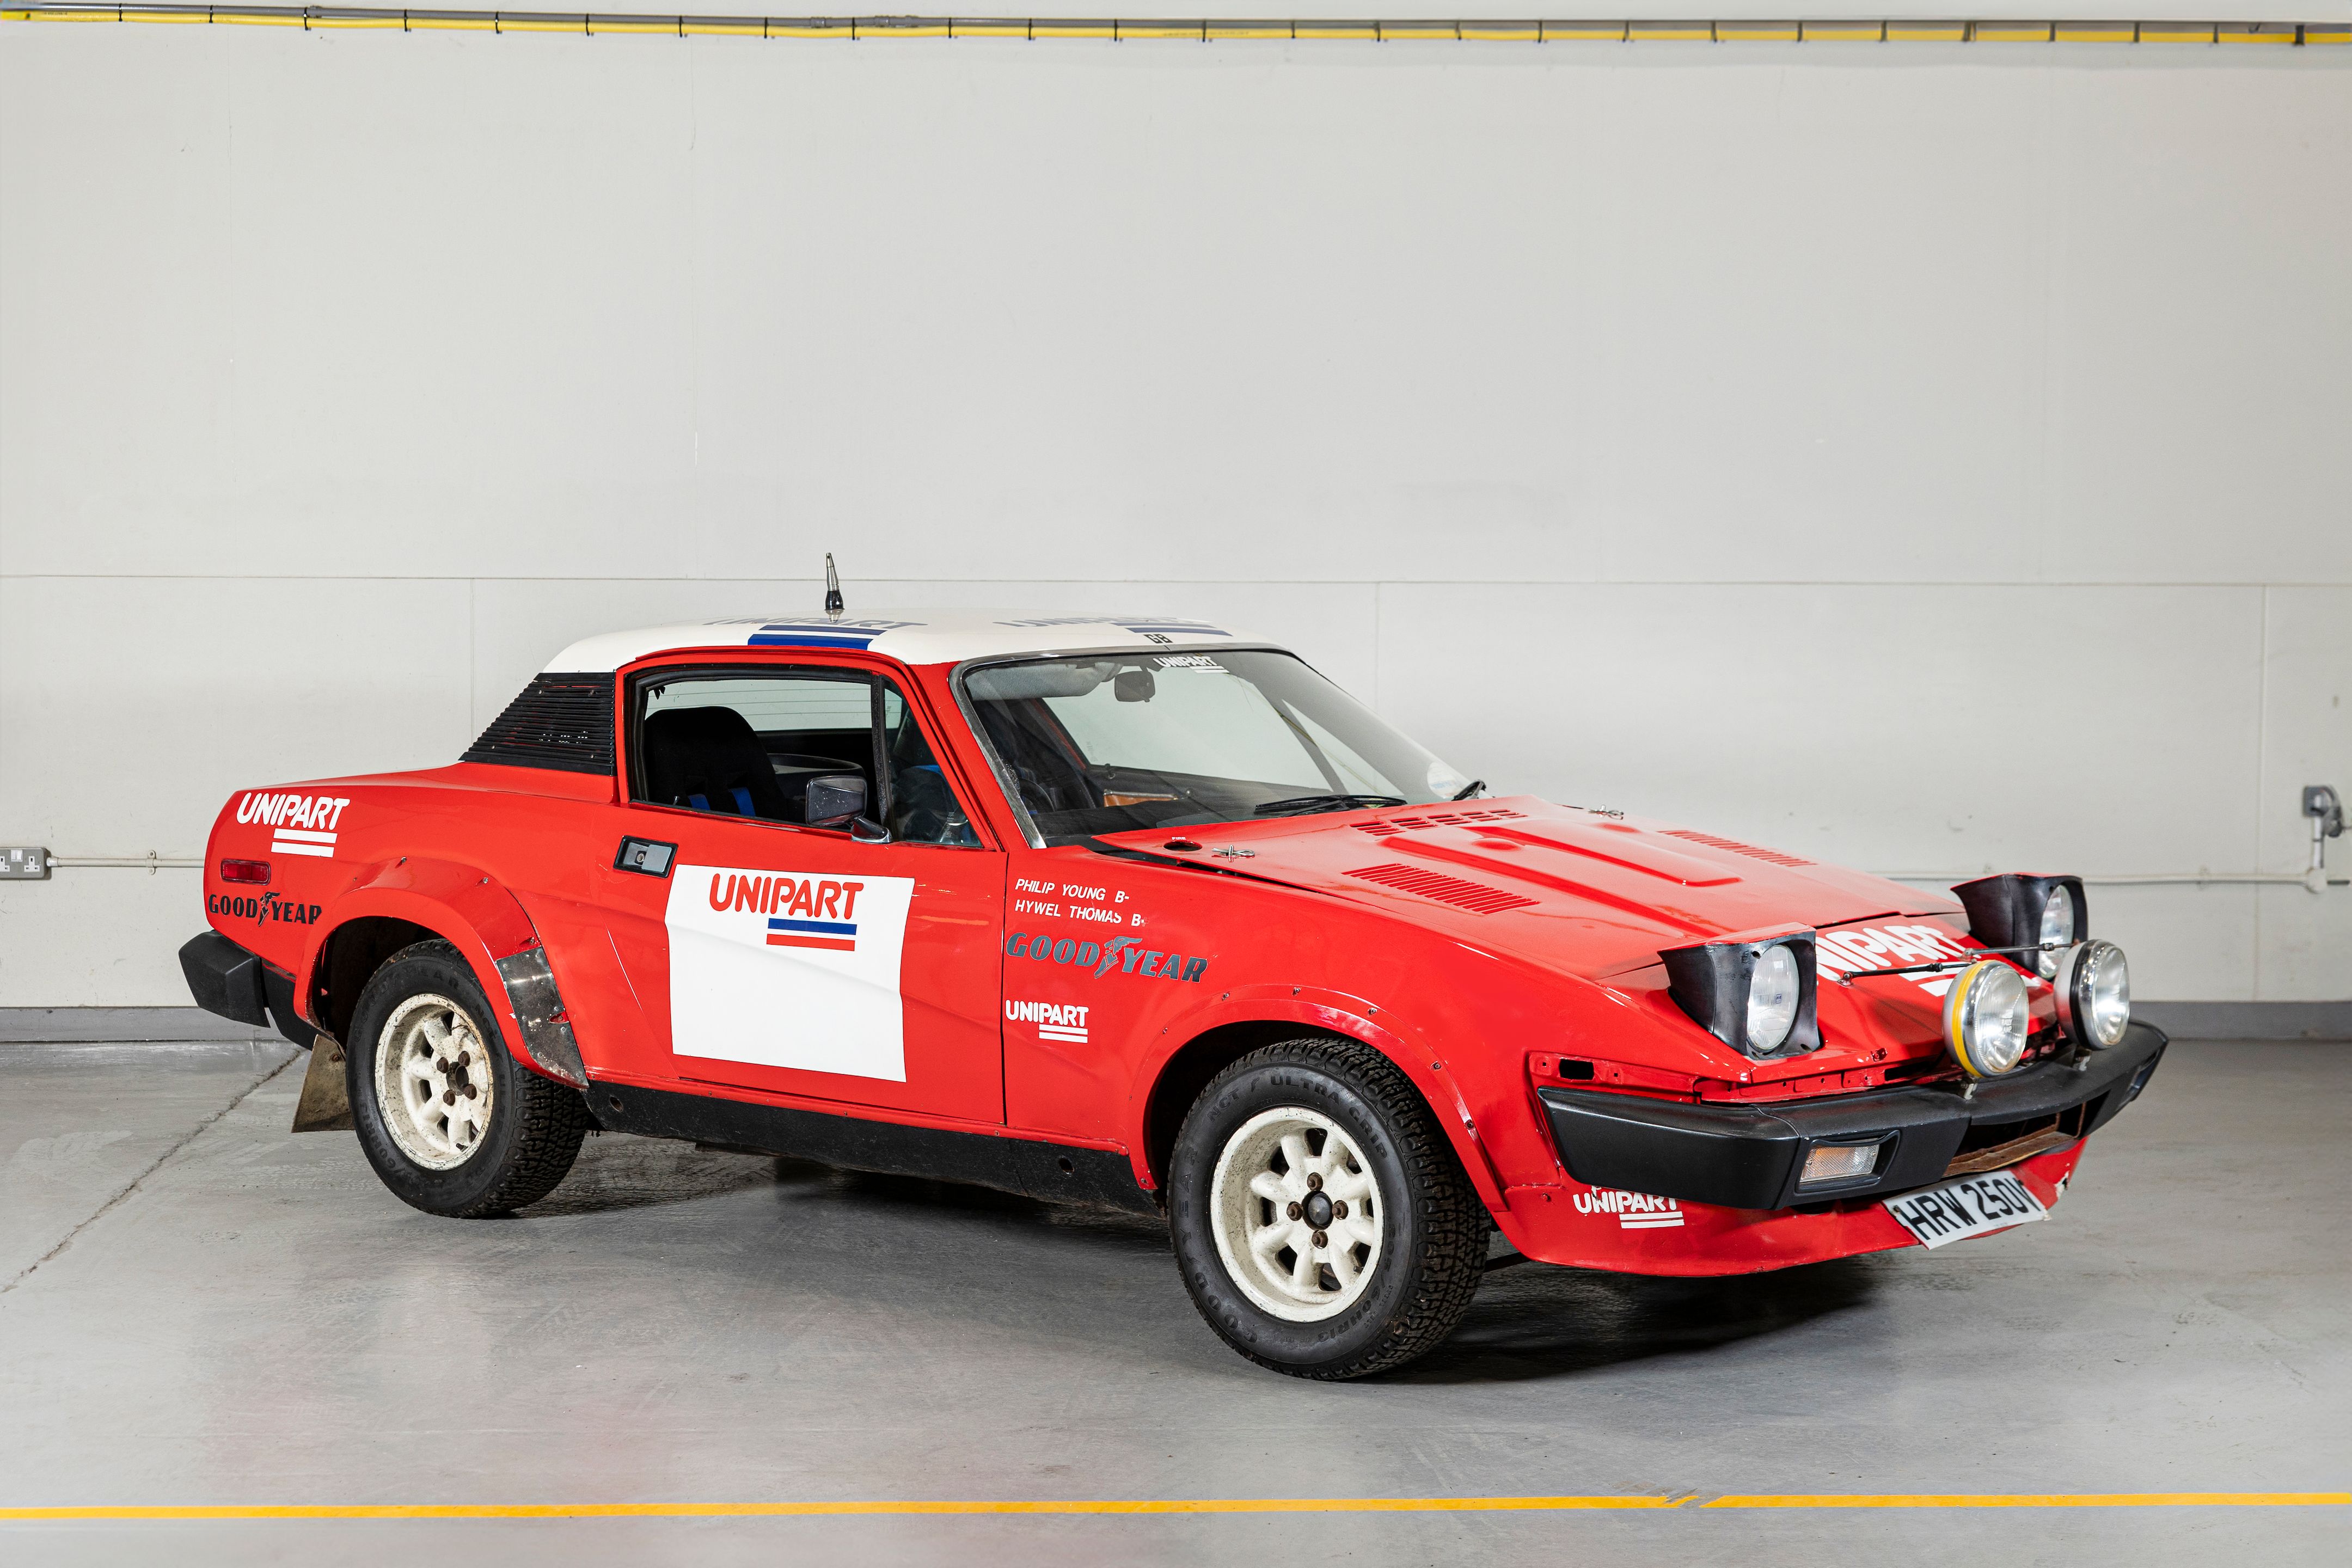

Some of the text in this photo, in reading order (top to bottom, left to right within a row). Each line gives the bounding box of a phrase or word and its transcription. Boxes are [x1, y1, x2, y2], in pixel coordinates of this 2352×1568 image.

[1143, 634, 1173, 644] GB
[1153, 656, 1217, 667] UNIPART
[236, 792, 350, 830] UNIPART
[709, 873, 864, 920] UNIPART
[1015, 878, 1055, 894] PHILIP
[1062, 884, 1106, 901] YOUNG
[1015, 899, 1061, 917] HYWEL
[1069, 905, 1122, 923] THOMAS
[1006, 932, 1208, 983] GOODYEAR
[1816, 926, 1981, 982] NIPART
[1006, 1000, 1089, 1027] UNIPART
[1207, 1075, 1388, 1159] NCT ULTRA GRIP
[1897, 1178, 2041, 1240] HRW 250V
